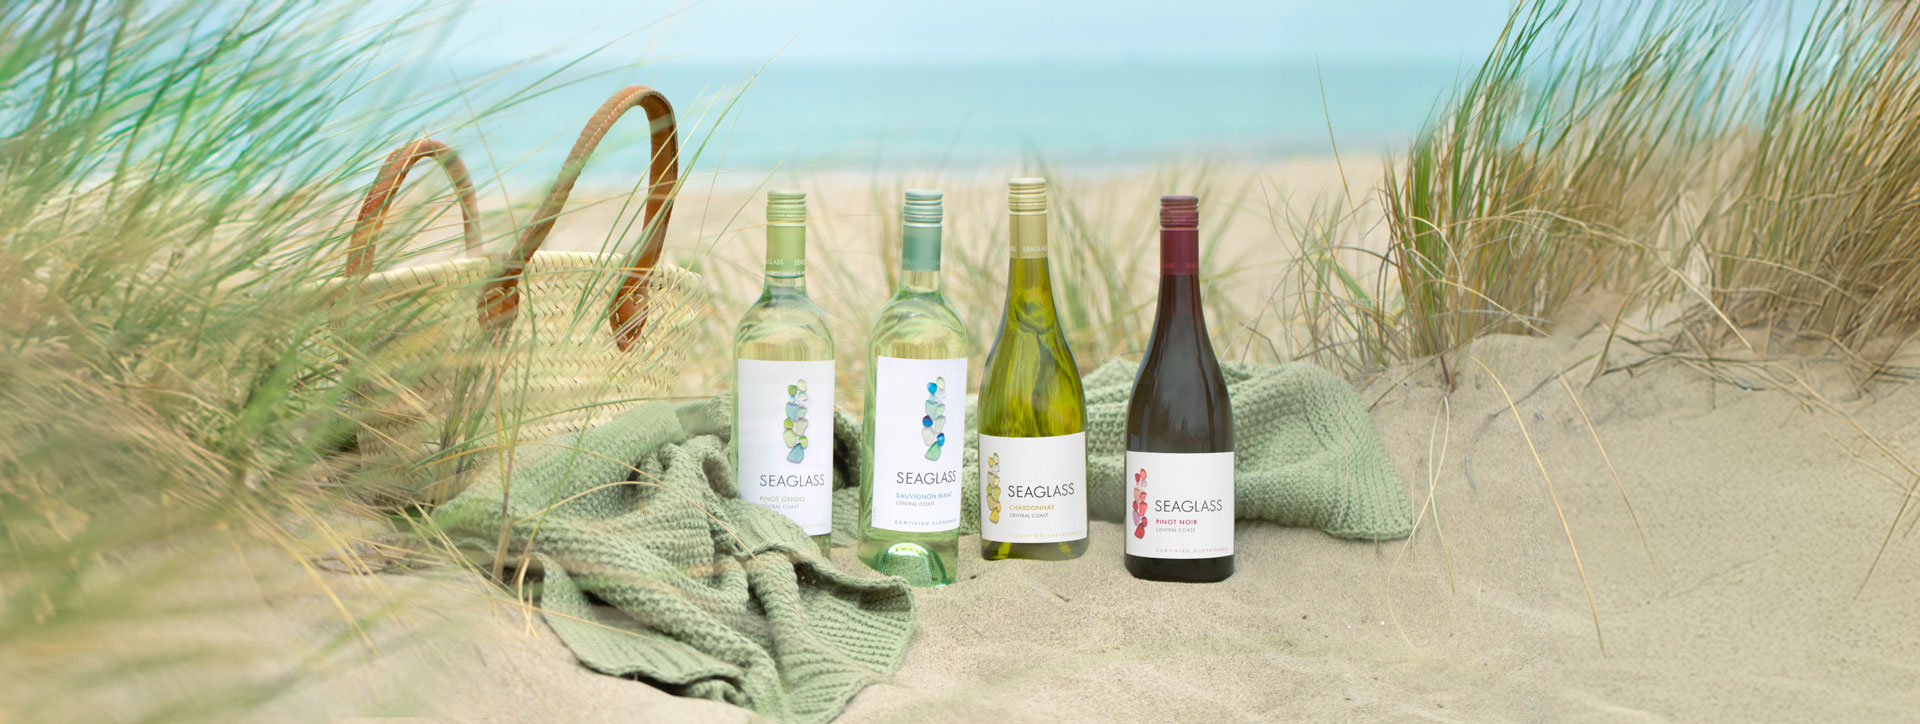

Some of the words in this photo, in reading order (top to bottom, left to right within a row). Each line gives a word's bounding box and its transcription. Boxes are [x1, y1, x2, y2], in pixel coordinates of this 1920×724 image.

[759, 474, 825, 487] SEAGLASS
[896, 470, 957, 485] SEAGLASS
[896, 492, 937, 500] SAUVIGNON
[937, 491, 953, 499] BLANC
[1007, 482, 1075, 499] SEAGLASS
[1154, 499, 1224, 513] SEAGLASS
